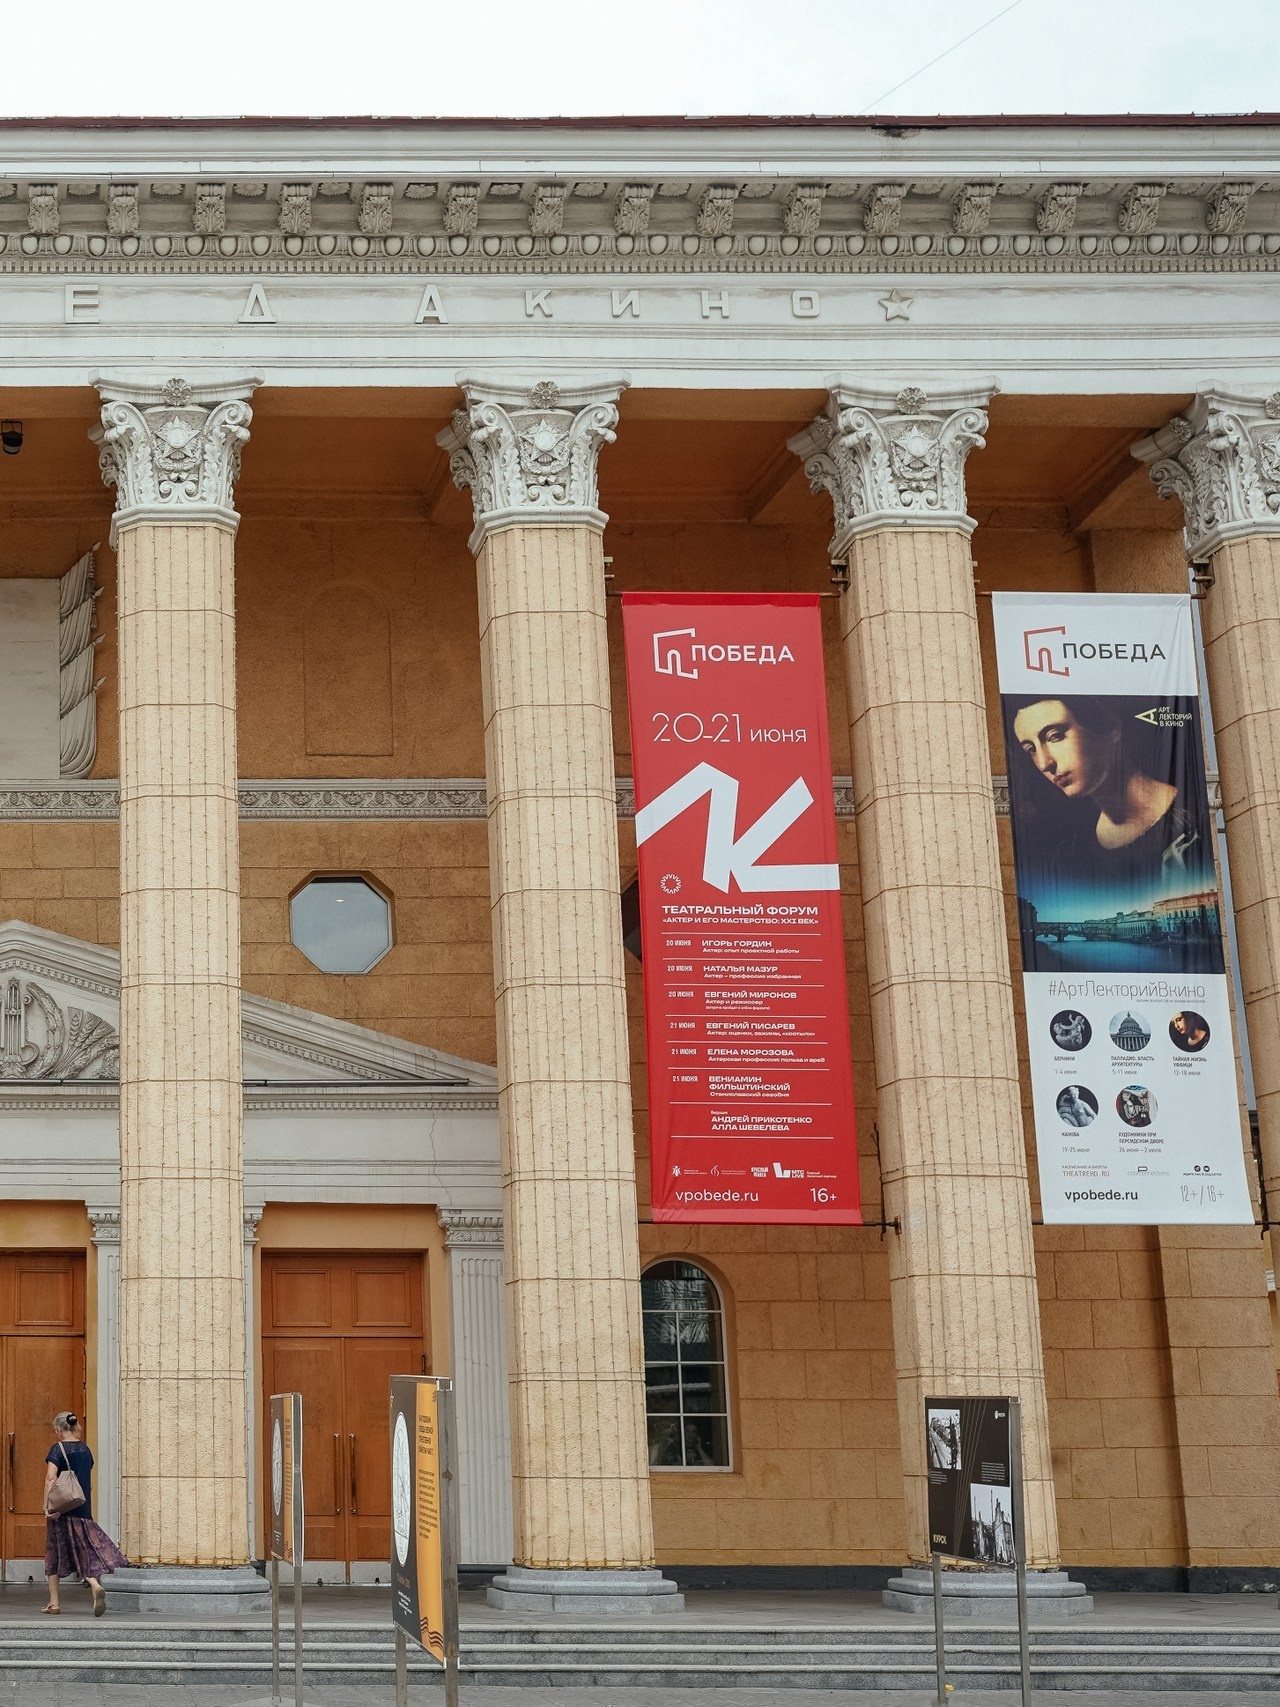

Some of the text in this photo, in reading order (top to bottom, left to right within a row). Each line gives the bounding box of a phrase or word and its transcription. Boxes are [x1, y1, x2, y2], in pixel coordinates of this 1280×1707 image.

[524, 289, 820, 318] КИНО
[691, 644, 795, 665] ПОБЕДА
[1062, 643, 1166, 663] ПОБЕДА
[1159, 713, 1193, 721] ЛЕКТОРИЙ
[652, 712, 742, 742] 20-21
[662, 903, 818, 916] ТЕАТРАЛЬНЫЙ ФОРУМ
[733, 940, 773, 948] ГОРДИН
[704, 990, 748, 998] ЕВГЕНИЙ
[1049, 980, 1206, 1000] #АртЛекторийВкино
[706, 1021, 750, 1029] ЕВГЕНИЙ
[707, 1048, 739, 1056] ЕЛЕНА
[709, 1083, 791, 1091] ФИЛЬШТИНСКИЙ
[711, 1115, 750, 1123] АНДРЕЙ
[675, 1189, 759, 1203] vpobede.ru
[810, 1187, 837, 1203] 16+
[1065, 1189, 1138, 1202] vpobede.ru
[1181, 1184, 1198, 1202] 12+
[1207, 1184, 1225, 1202] 16+
